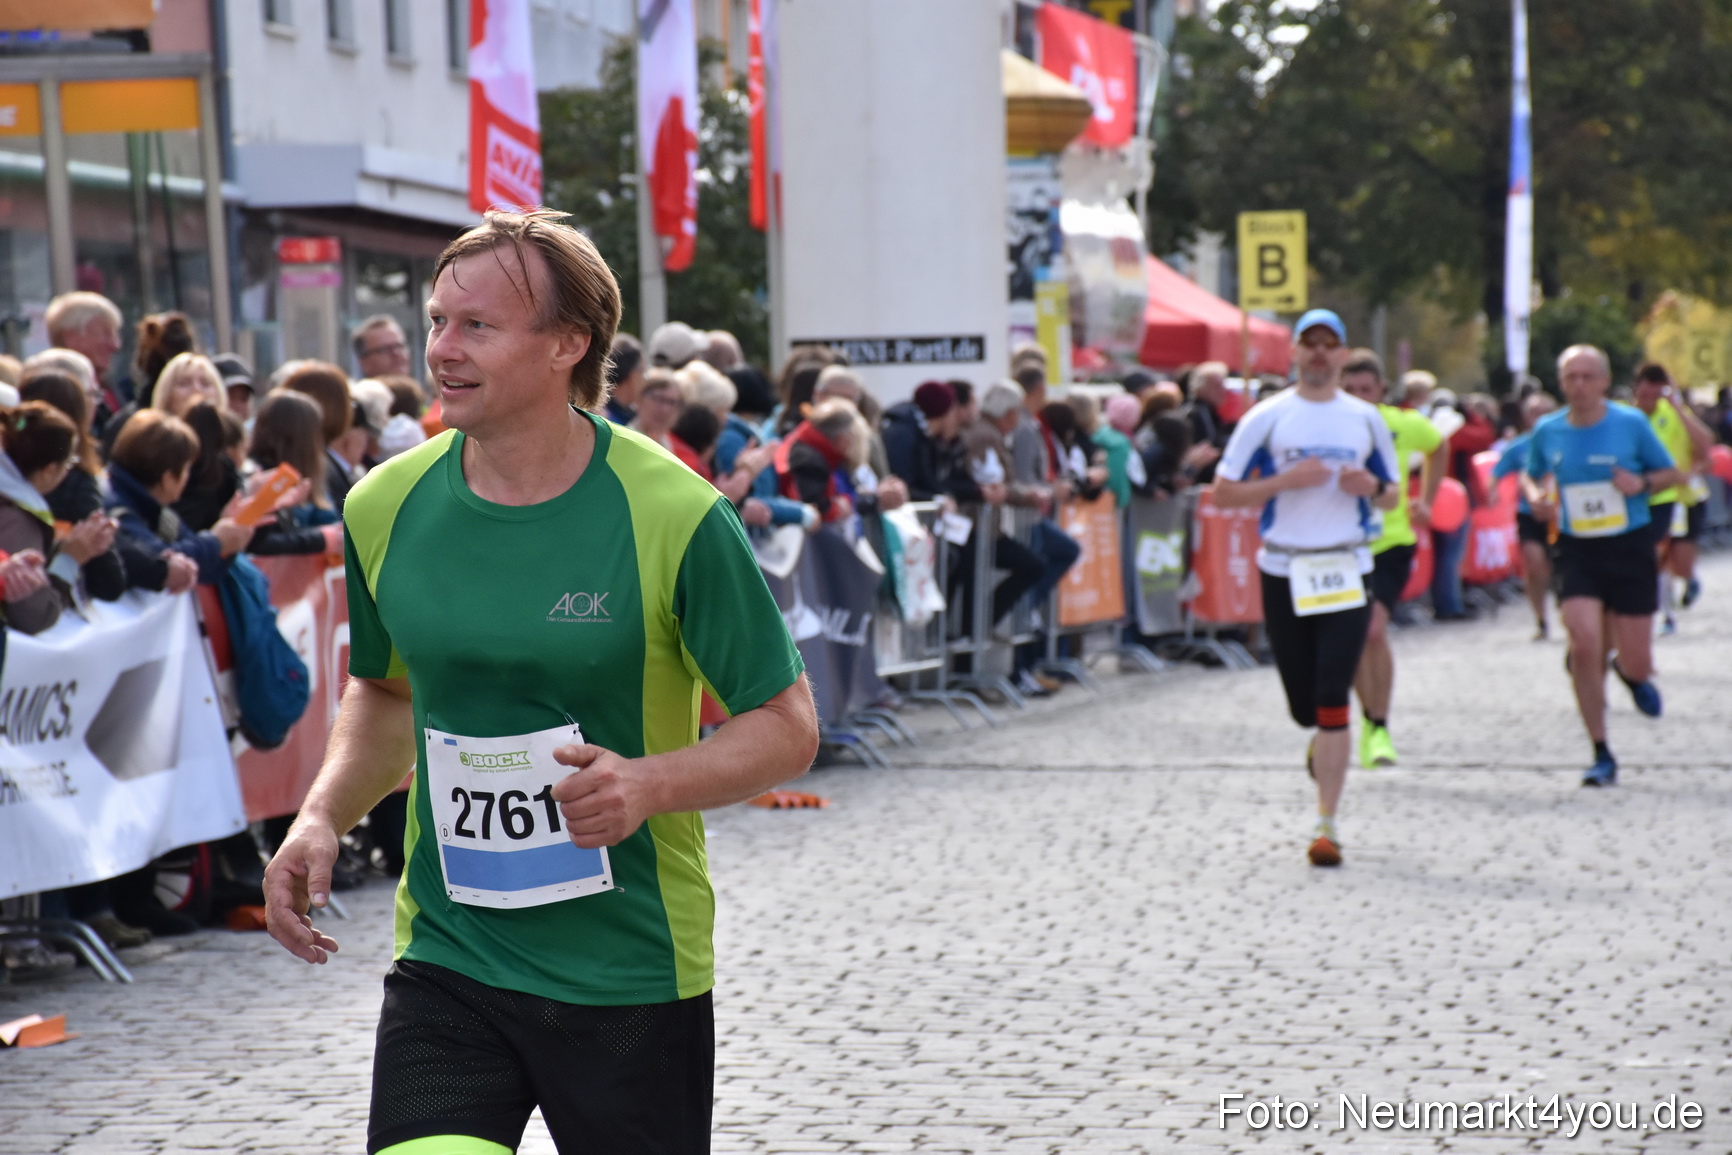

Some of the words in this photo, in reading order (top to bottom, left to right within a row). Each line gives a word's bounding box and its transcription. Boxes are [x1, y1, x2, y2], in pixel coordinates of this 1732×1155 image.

[1257, 243, 1290, 289] B
[548, 591, 610, 617] AOK
[470, 751, 531, 768] BOCK
[451, 784, 562, 841] 2761
